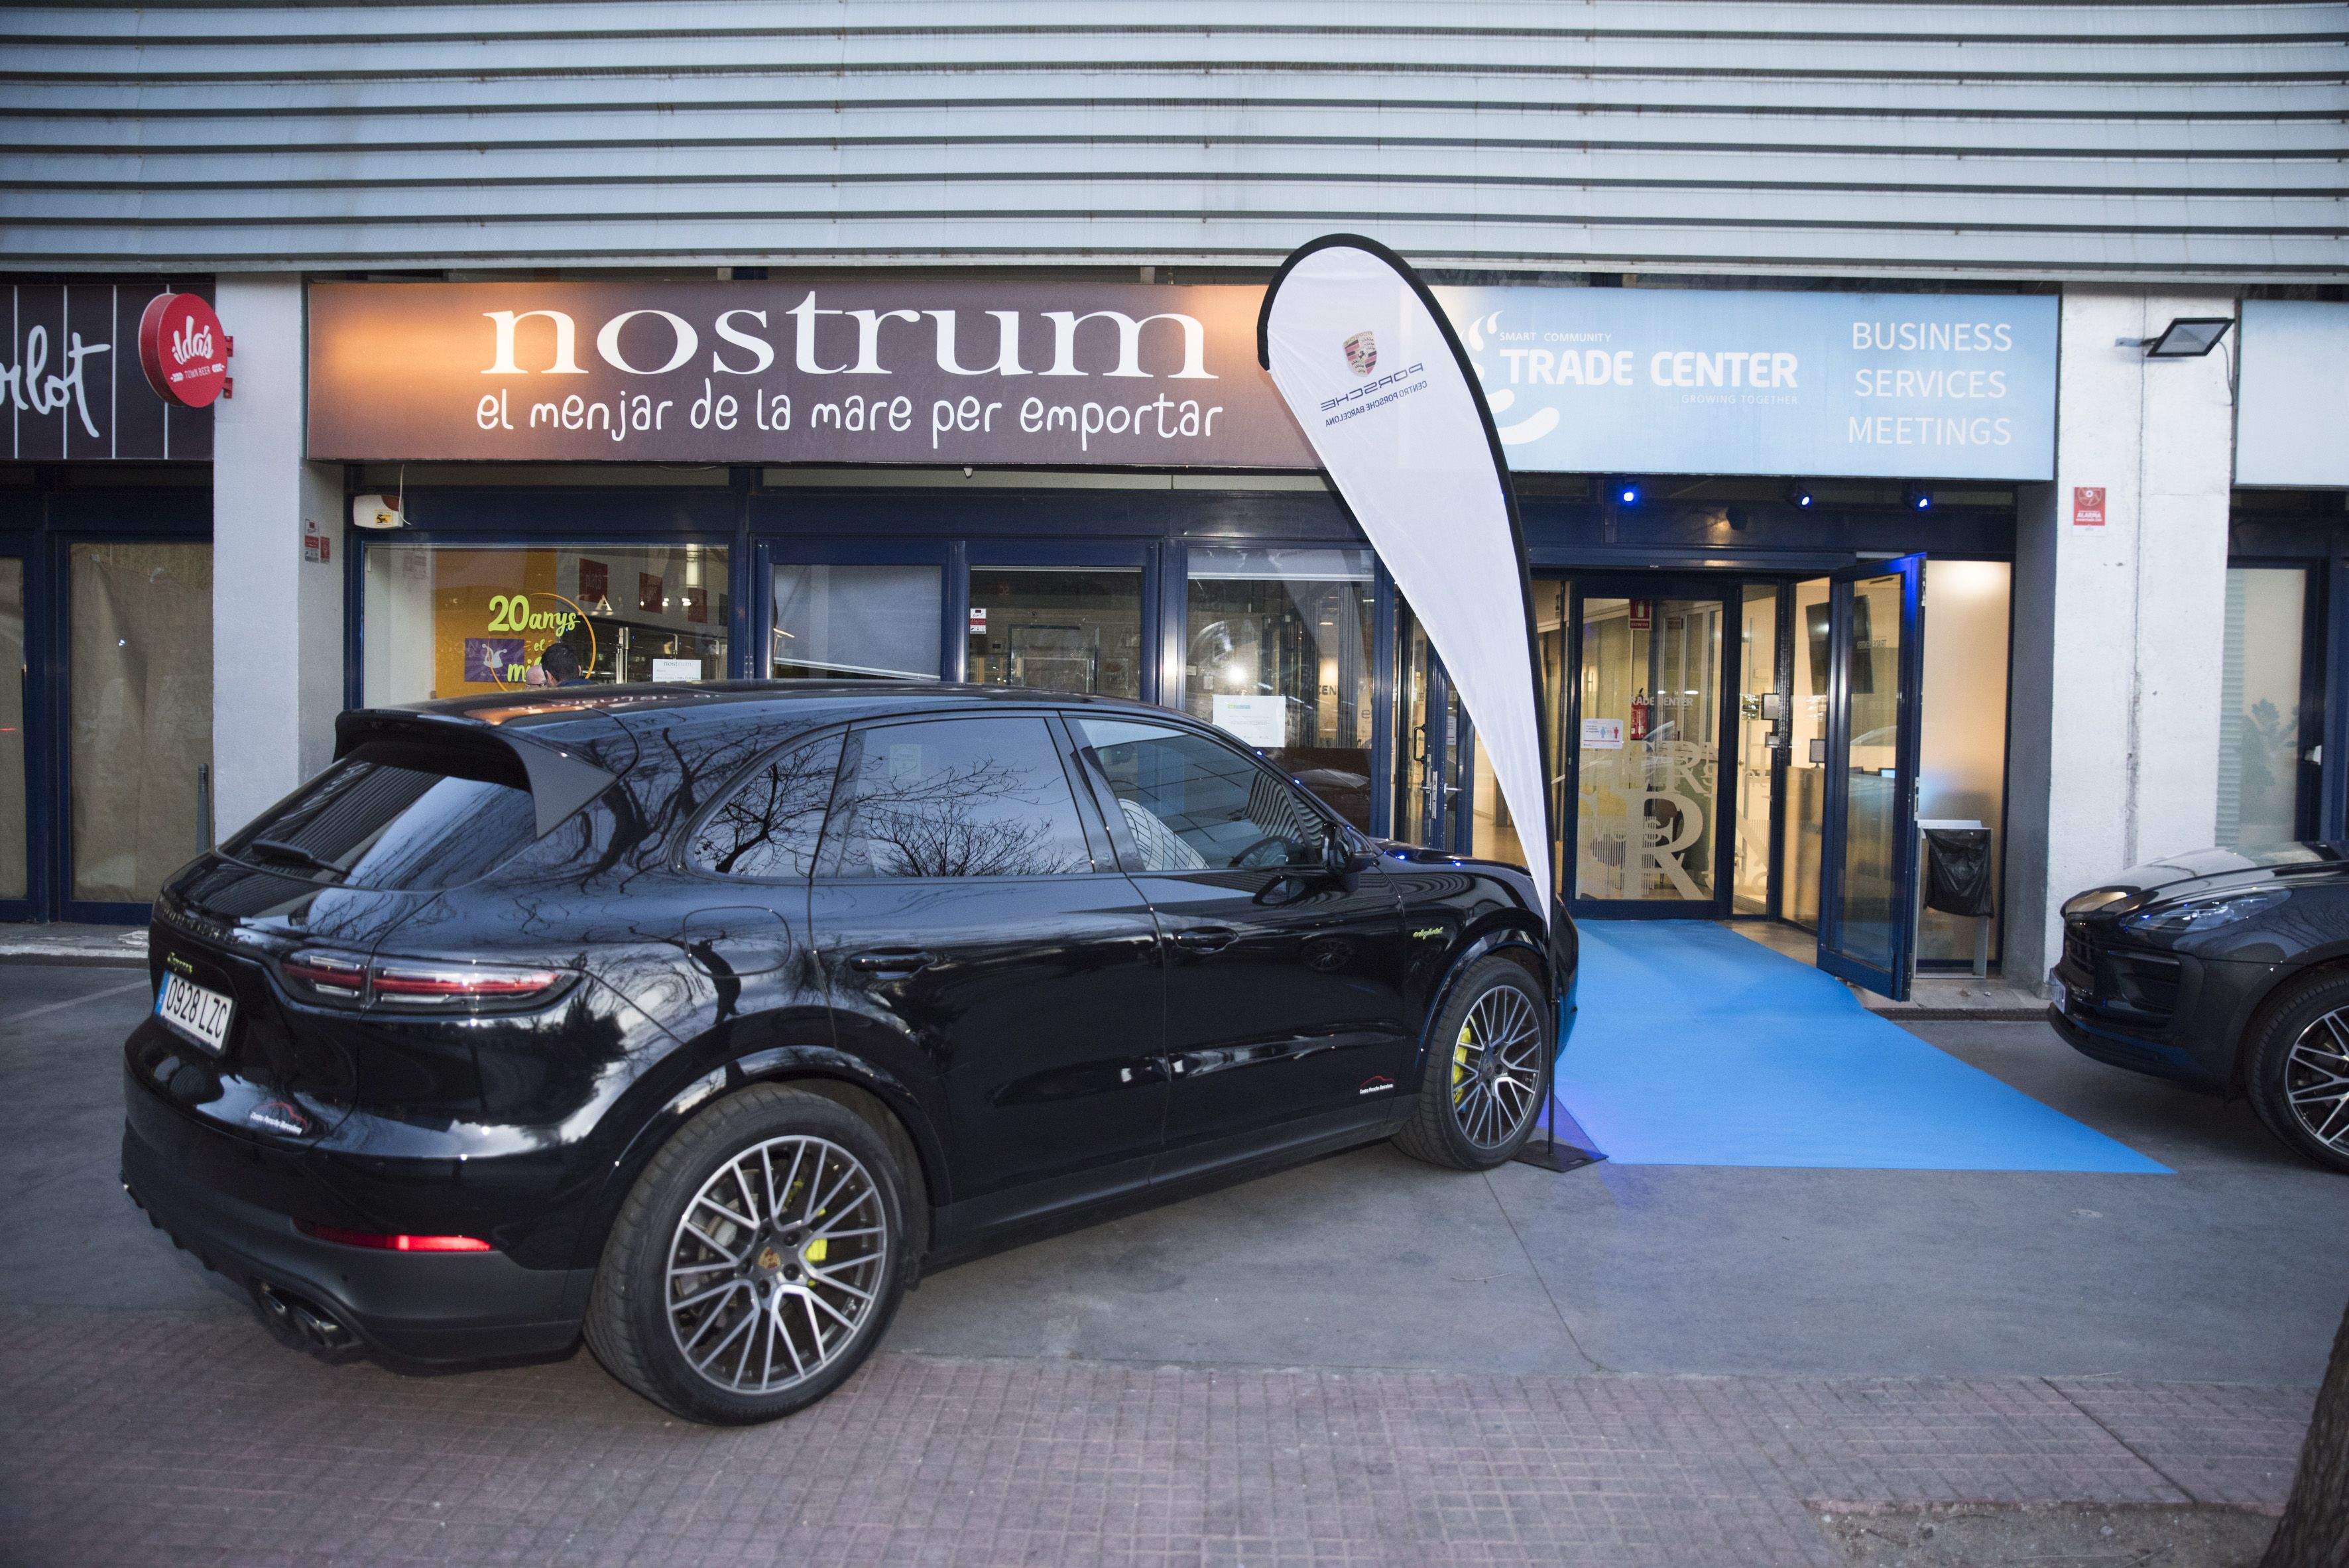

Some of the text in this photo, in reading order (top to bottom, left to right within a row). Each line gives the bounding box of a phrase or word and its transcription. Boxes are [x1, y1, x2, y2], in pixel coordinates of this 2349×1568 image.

[480, 290, 1219, 379] nostrum
[1500, 332, 1612, 342] SMART COMMUNITY
[1852, 322, 2013, 351] BUSINESS
[1500, 349, 1798, 388] TRADE CENTER
[1854, 369, 2008, 398] SERVICES
[477, 377, 1223, 451] el menjar de la mare per emportar
[1681, 394, 1798, 405] GROWING TOGETHER
[1848, 416, 2012, 446] MEETINGS
[534, 638, 545, 651] el
[166, 977, 227, 1038] 0928 LZC
